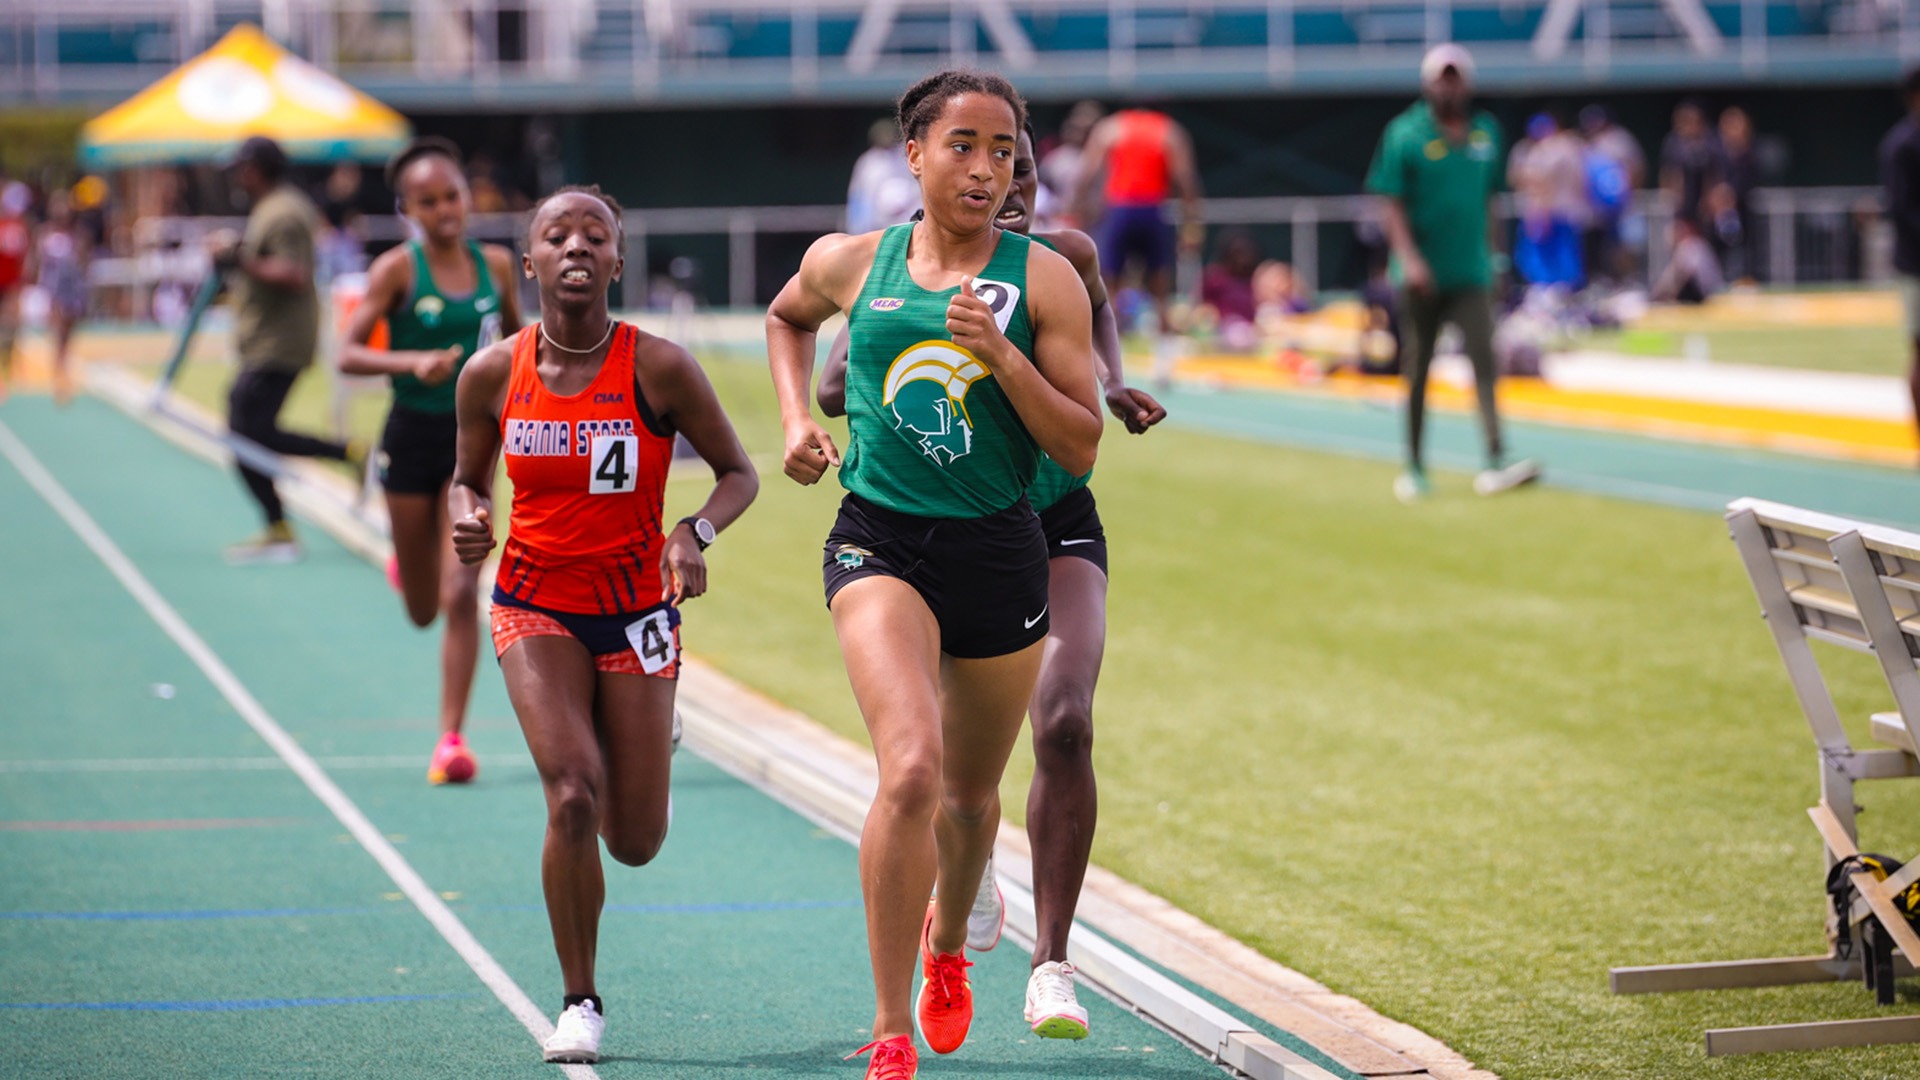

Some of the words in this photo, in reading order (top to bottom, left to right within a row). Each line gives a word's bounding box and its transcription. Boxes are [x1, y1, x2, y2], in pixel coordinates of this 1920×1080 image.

[870, 299, 904, 309] MEAC
[593, 393, 624, 404] CIAA
[595, 440, 629, 489] 4
[641, 617, 669, 662] 4
